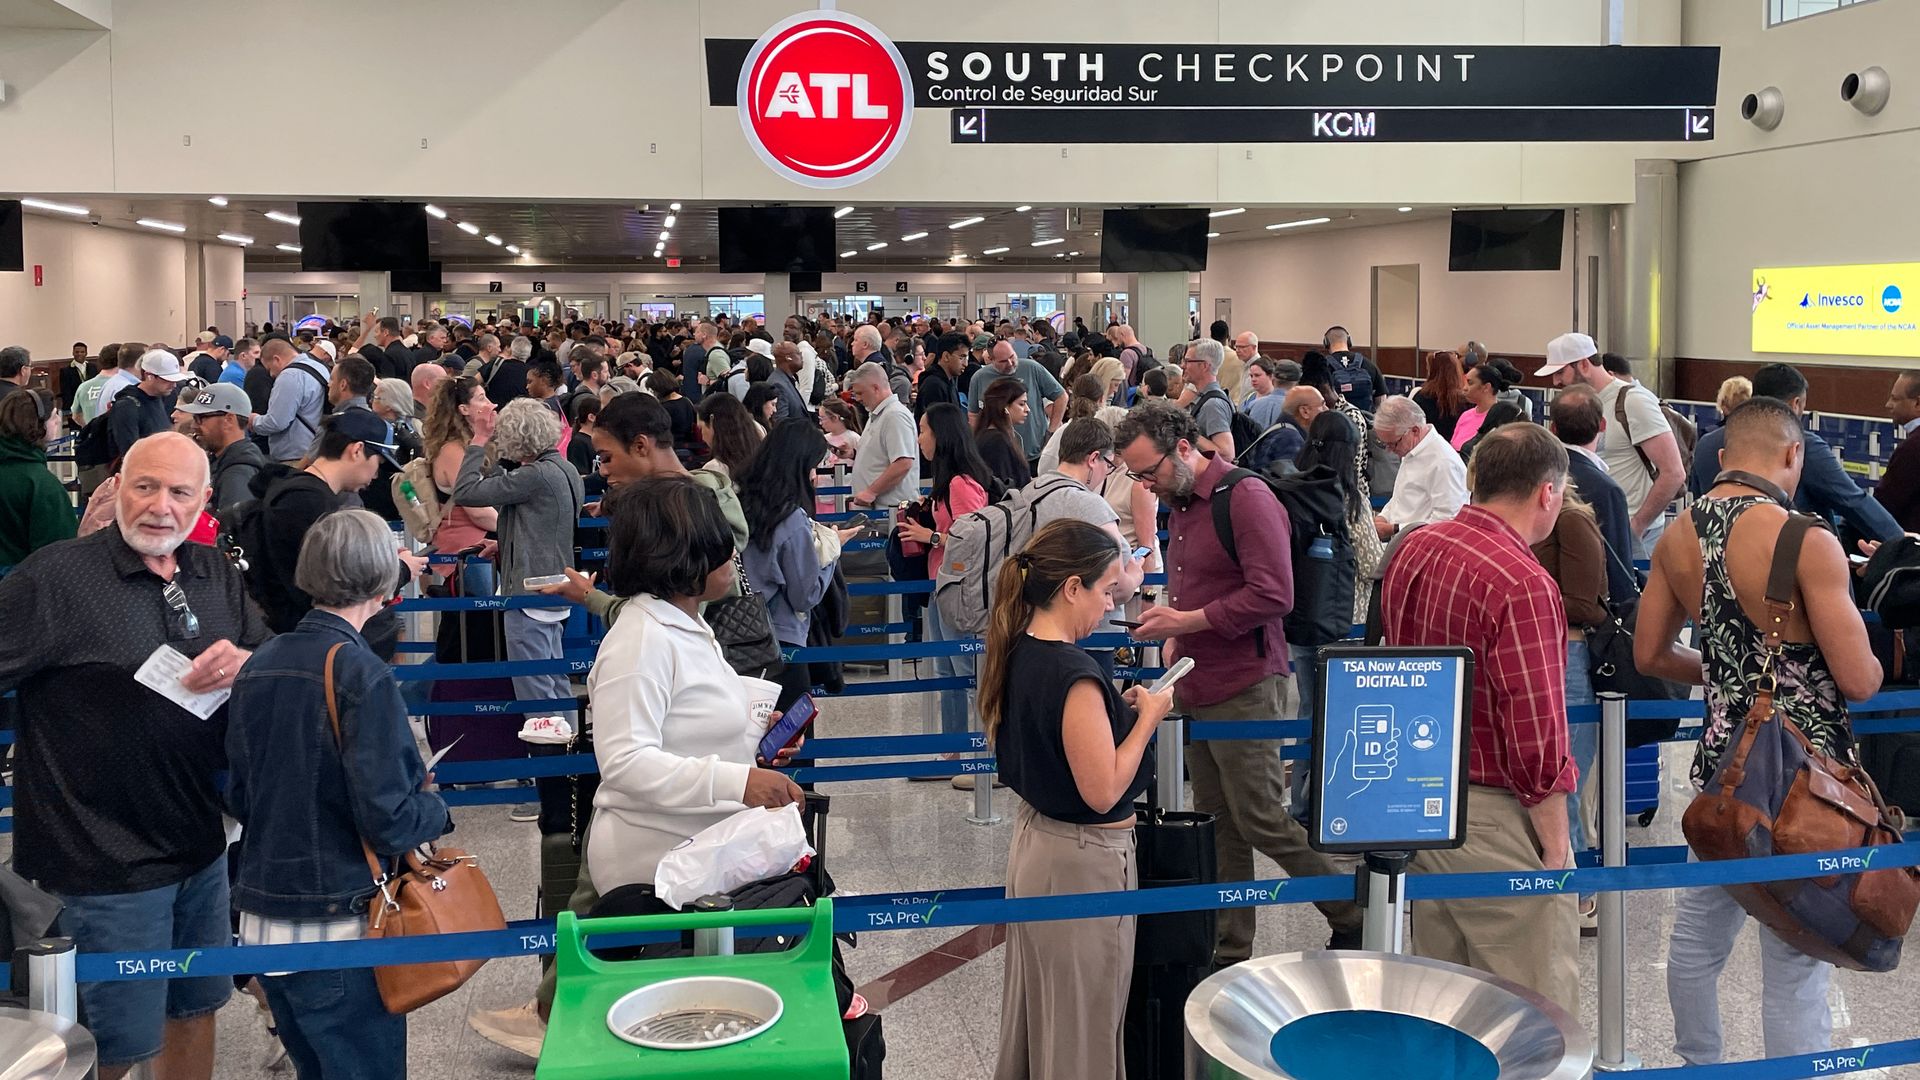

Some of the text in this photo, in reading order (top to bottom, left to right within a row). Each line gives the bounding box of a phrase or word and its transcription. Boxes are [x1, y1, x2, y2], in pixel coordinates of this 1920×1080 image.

[926, 51, 1475, 82] SOUTH CHECKPOINT
[764, 71, 888, 119] ATL
[928, 85, 1158, 104] Control de Seguridad Sur
[1313, 111, 1376, 136] KCM
[493, 283, 499, 292] 7
[535, 283, 543, 292] 6
[859, 283, 865, 292] 5
[898, 283, 905, 292] 4
[1818, 293, 1864, 306] Invesco
[960, 644, 974, 652] TSA
[570, 662, 587, 670] TSA
[1343, 660, 1442, 673] TSA Now Accepts
[1356, 674, 1428, 688] DIGITAL ID.
[474, 704, 488, 712] TSA
[752, 702, 763, 710] JIM
[971, 737, 988, 747] TSA
[1364, 741, 1382, 756] ID
[961, 762, 991, 771] TSA Pre
[1818, 856, 1860, 871] TSA Pre
[1509, 878, 1554, 891] TSA Pre
[1218, 888, 1268, 902] TSA Pre
[867, 911, 920, 926] TSA Pre
[520, 935, 548, 949] TSA
[116, 959, 176, 974] TSA Pre
[1812, 1056, 1856, 1072] TSA Pre
